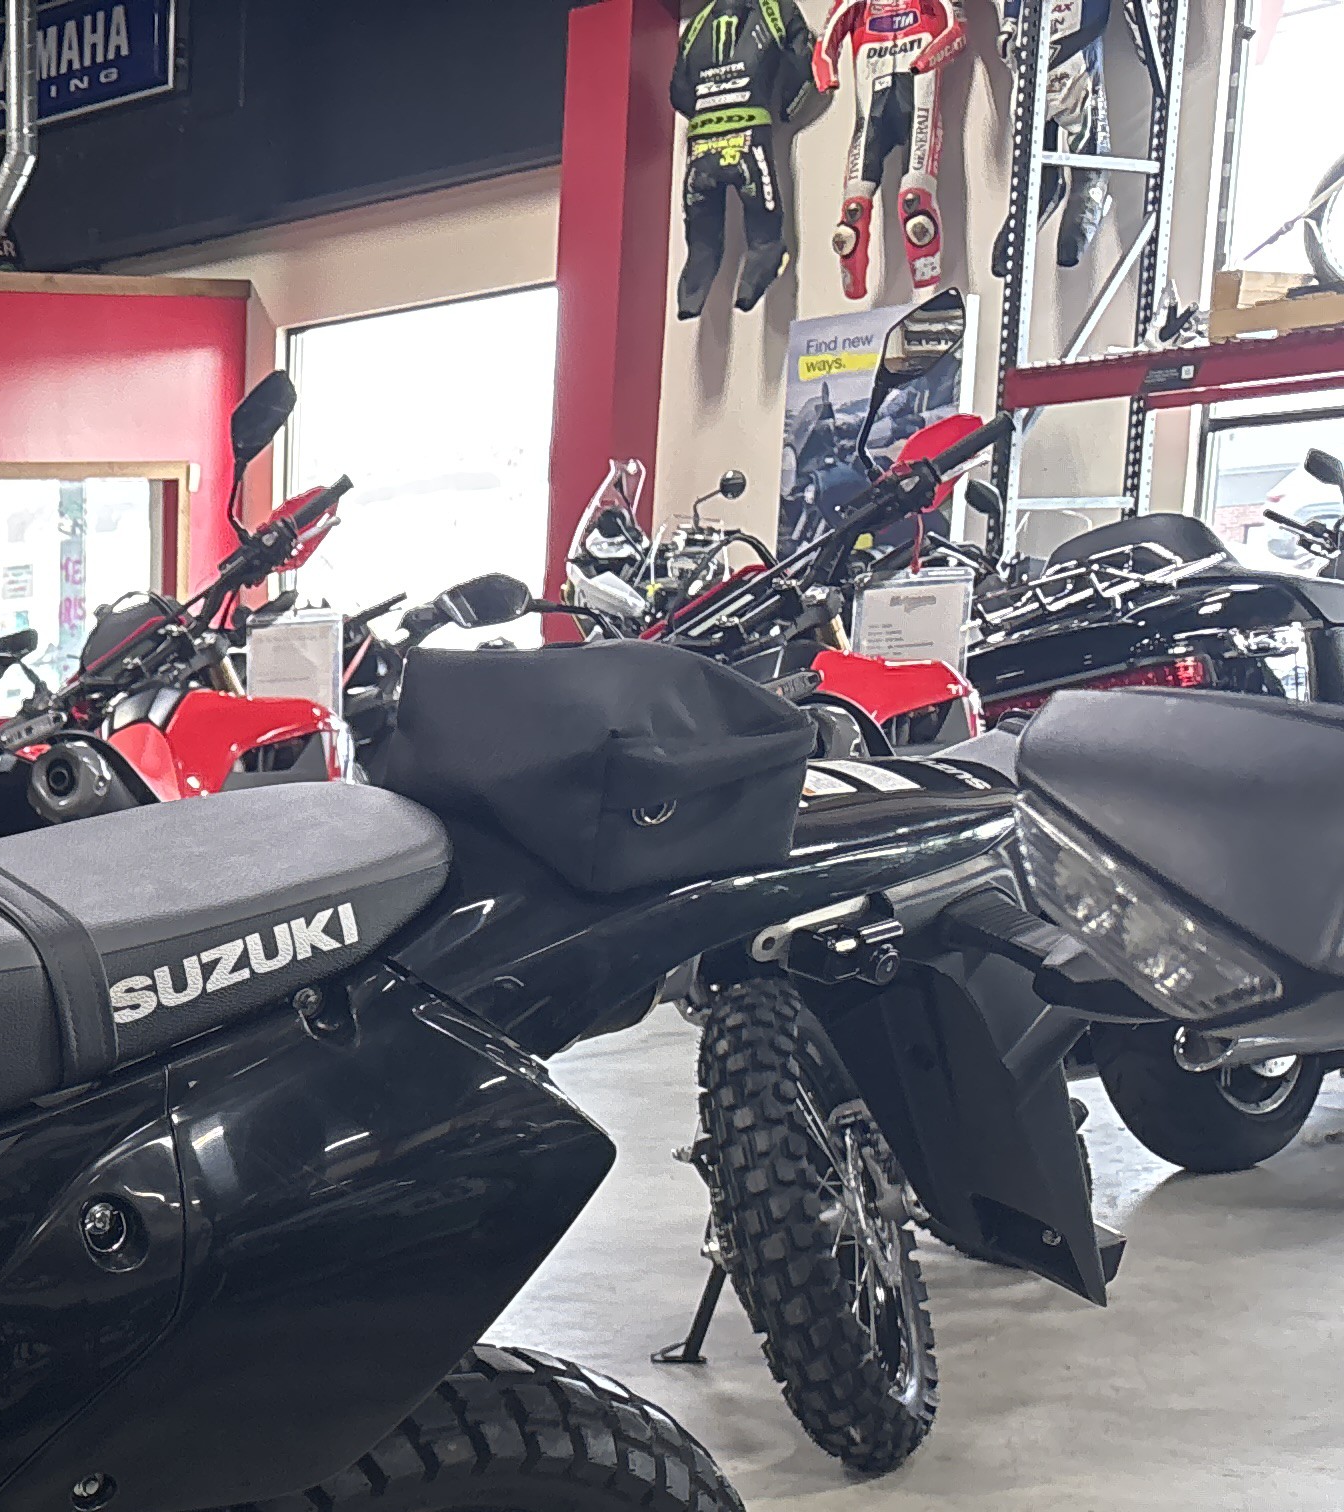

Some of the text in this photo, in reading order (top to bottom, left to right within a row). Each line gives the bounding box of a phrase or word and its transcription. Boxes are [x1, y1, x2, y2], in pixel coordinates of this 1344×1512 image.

[866, 37, 923, 59] DUCATI
[805, 333, 874, 355] Find new
[804, 357, 846, 374] ways.
[109, 902, 359, 1023] SUZUKI
